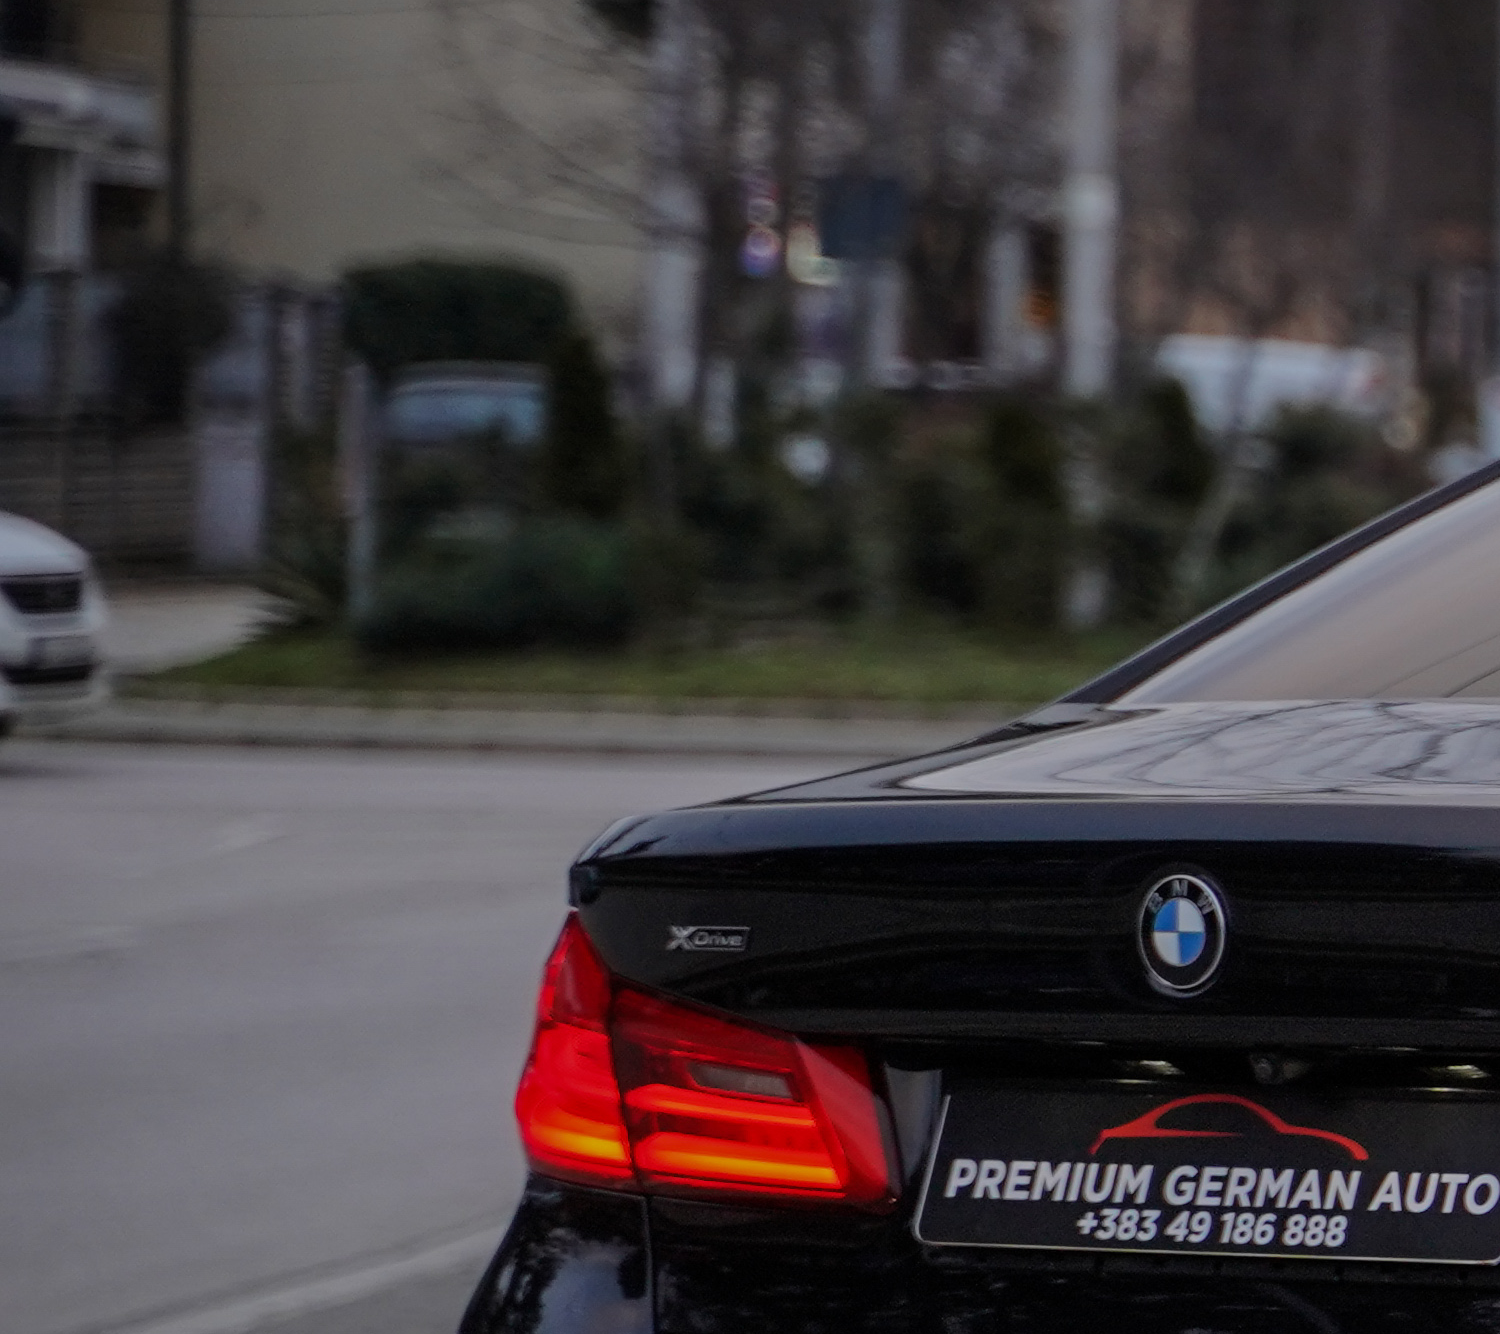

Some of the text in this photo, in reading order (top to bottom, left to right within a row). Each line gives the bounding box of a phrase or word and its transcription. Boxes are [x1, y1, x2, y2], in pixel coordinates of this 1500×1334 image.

[943, 1158, 1155, 1205] PREMIUM
[1162, 1163, 1363, 1212] GERMAN
[1076, 1208, 1349, 1249] +383 49 186 888
